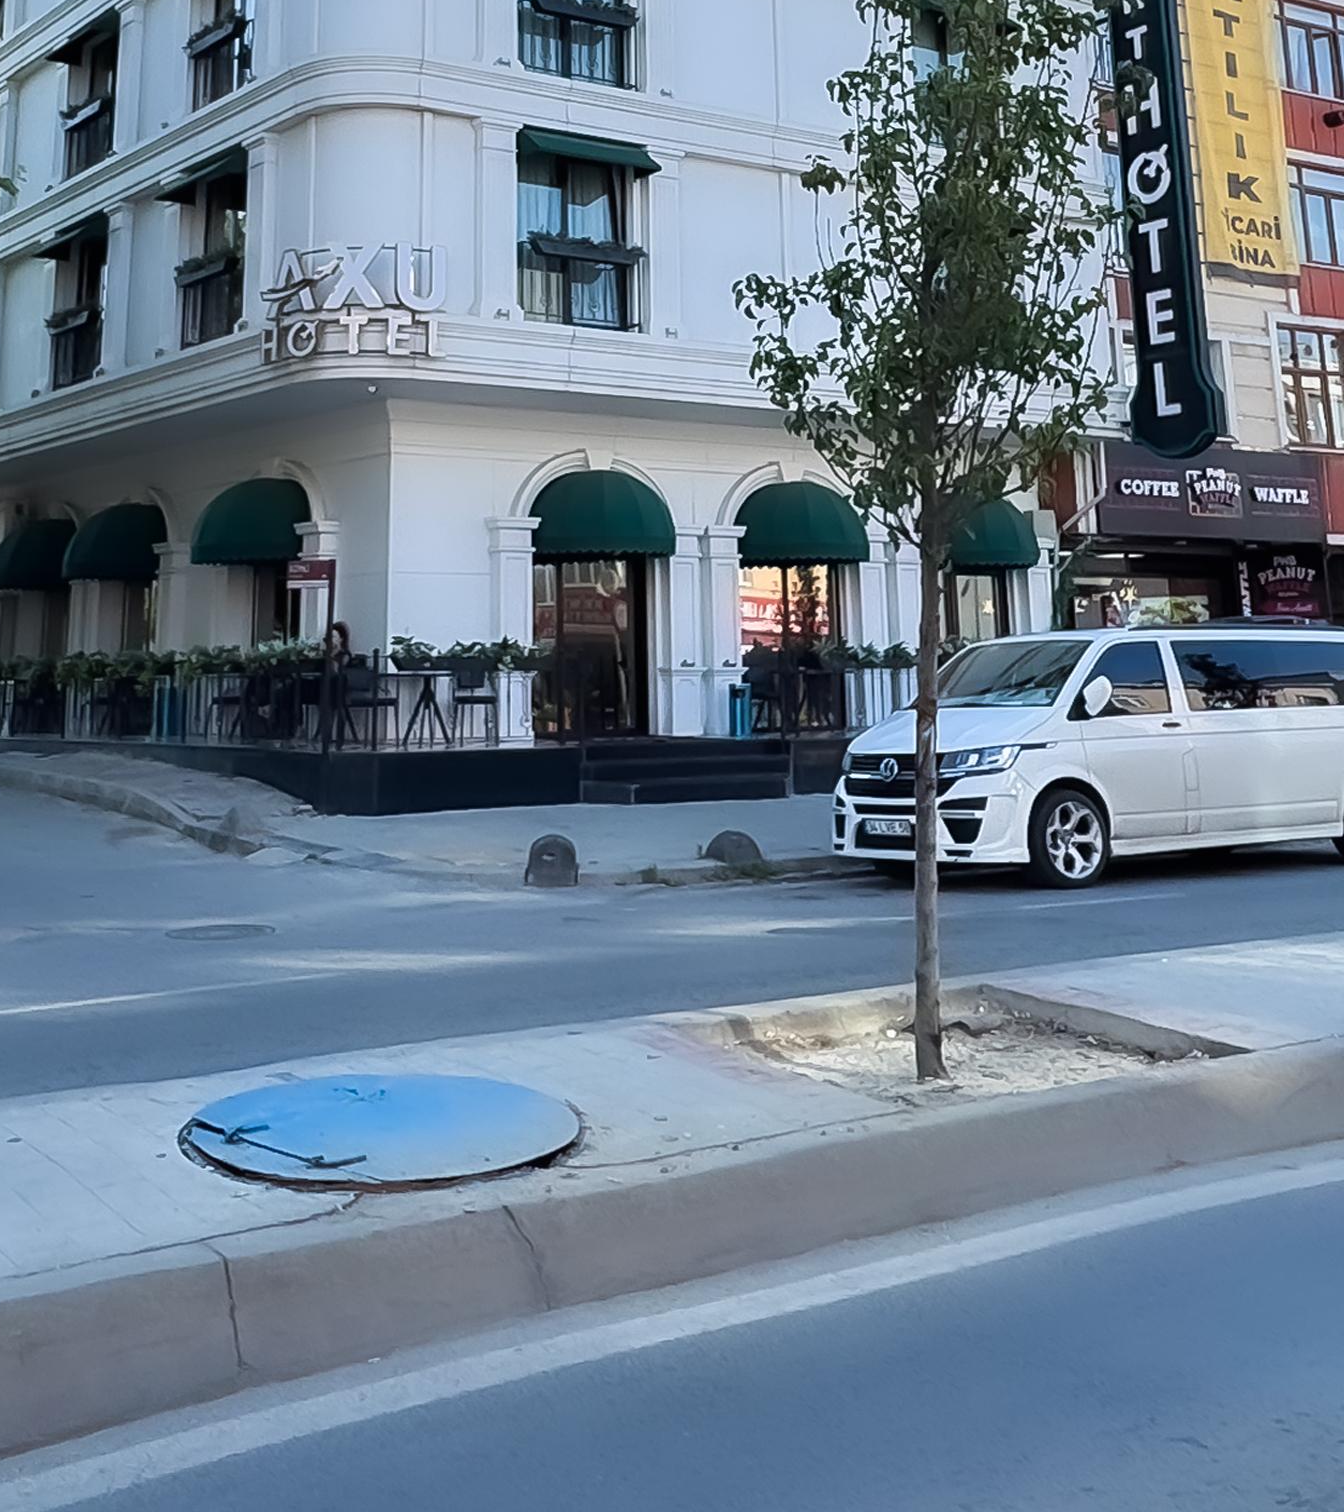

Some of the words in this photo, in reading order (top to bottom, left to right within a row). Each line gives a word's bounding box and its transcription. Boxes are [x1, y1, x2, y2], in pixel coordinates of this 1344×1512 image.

[1126, 75, 1183, 418] HOTEL
[260, 242, 449, 320] AXU
[260, 314, 447, 365] HOTEL
[1120, 478, 1180, 497] COFFEE
[1193, 478, 1242, 497] PEANUT
[1253, 486, 1310, 505] WAFFLE
[1257, 566, 1316, 585] PEANUT
